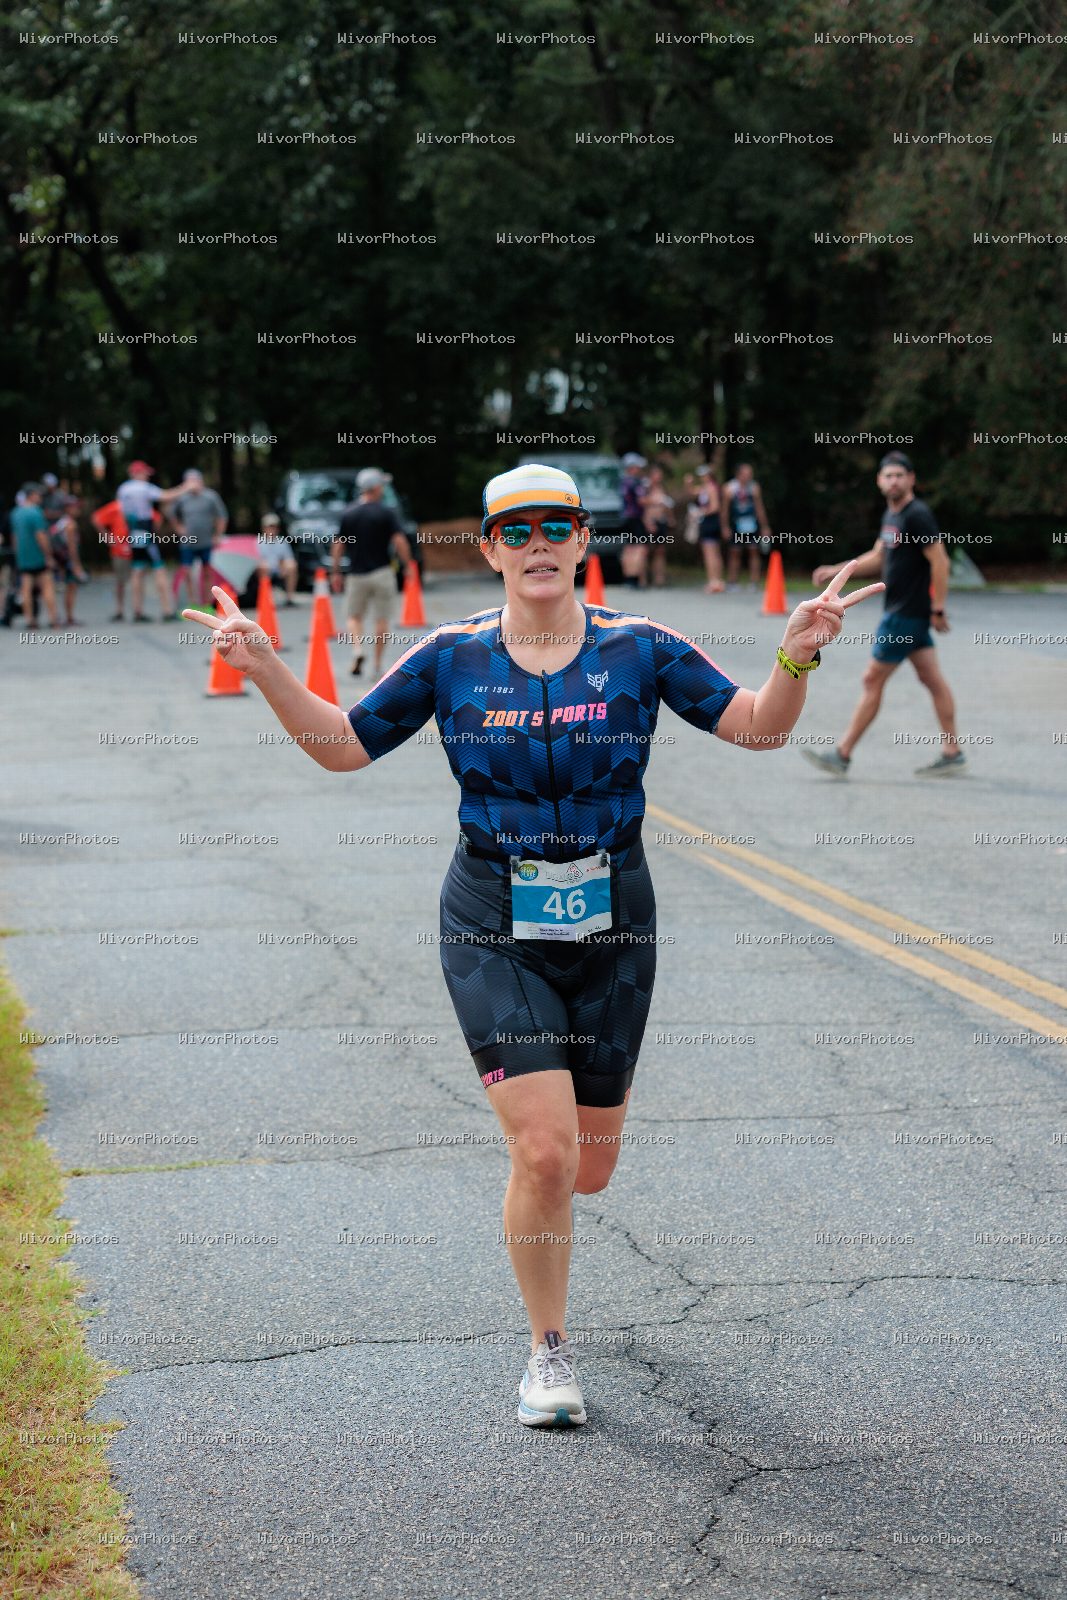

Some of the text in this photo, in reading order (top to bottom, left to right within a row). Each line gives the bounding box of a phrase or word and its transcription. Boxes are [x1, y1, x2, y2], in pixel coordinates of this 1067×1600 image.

[492, 686, 515, 694] 1983
[482, 710, 529, 728] ZOOT
[543, 889, 587, 920] 46
